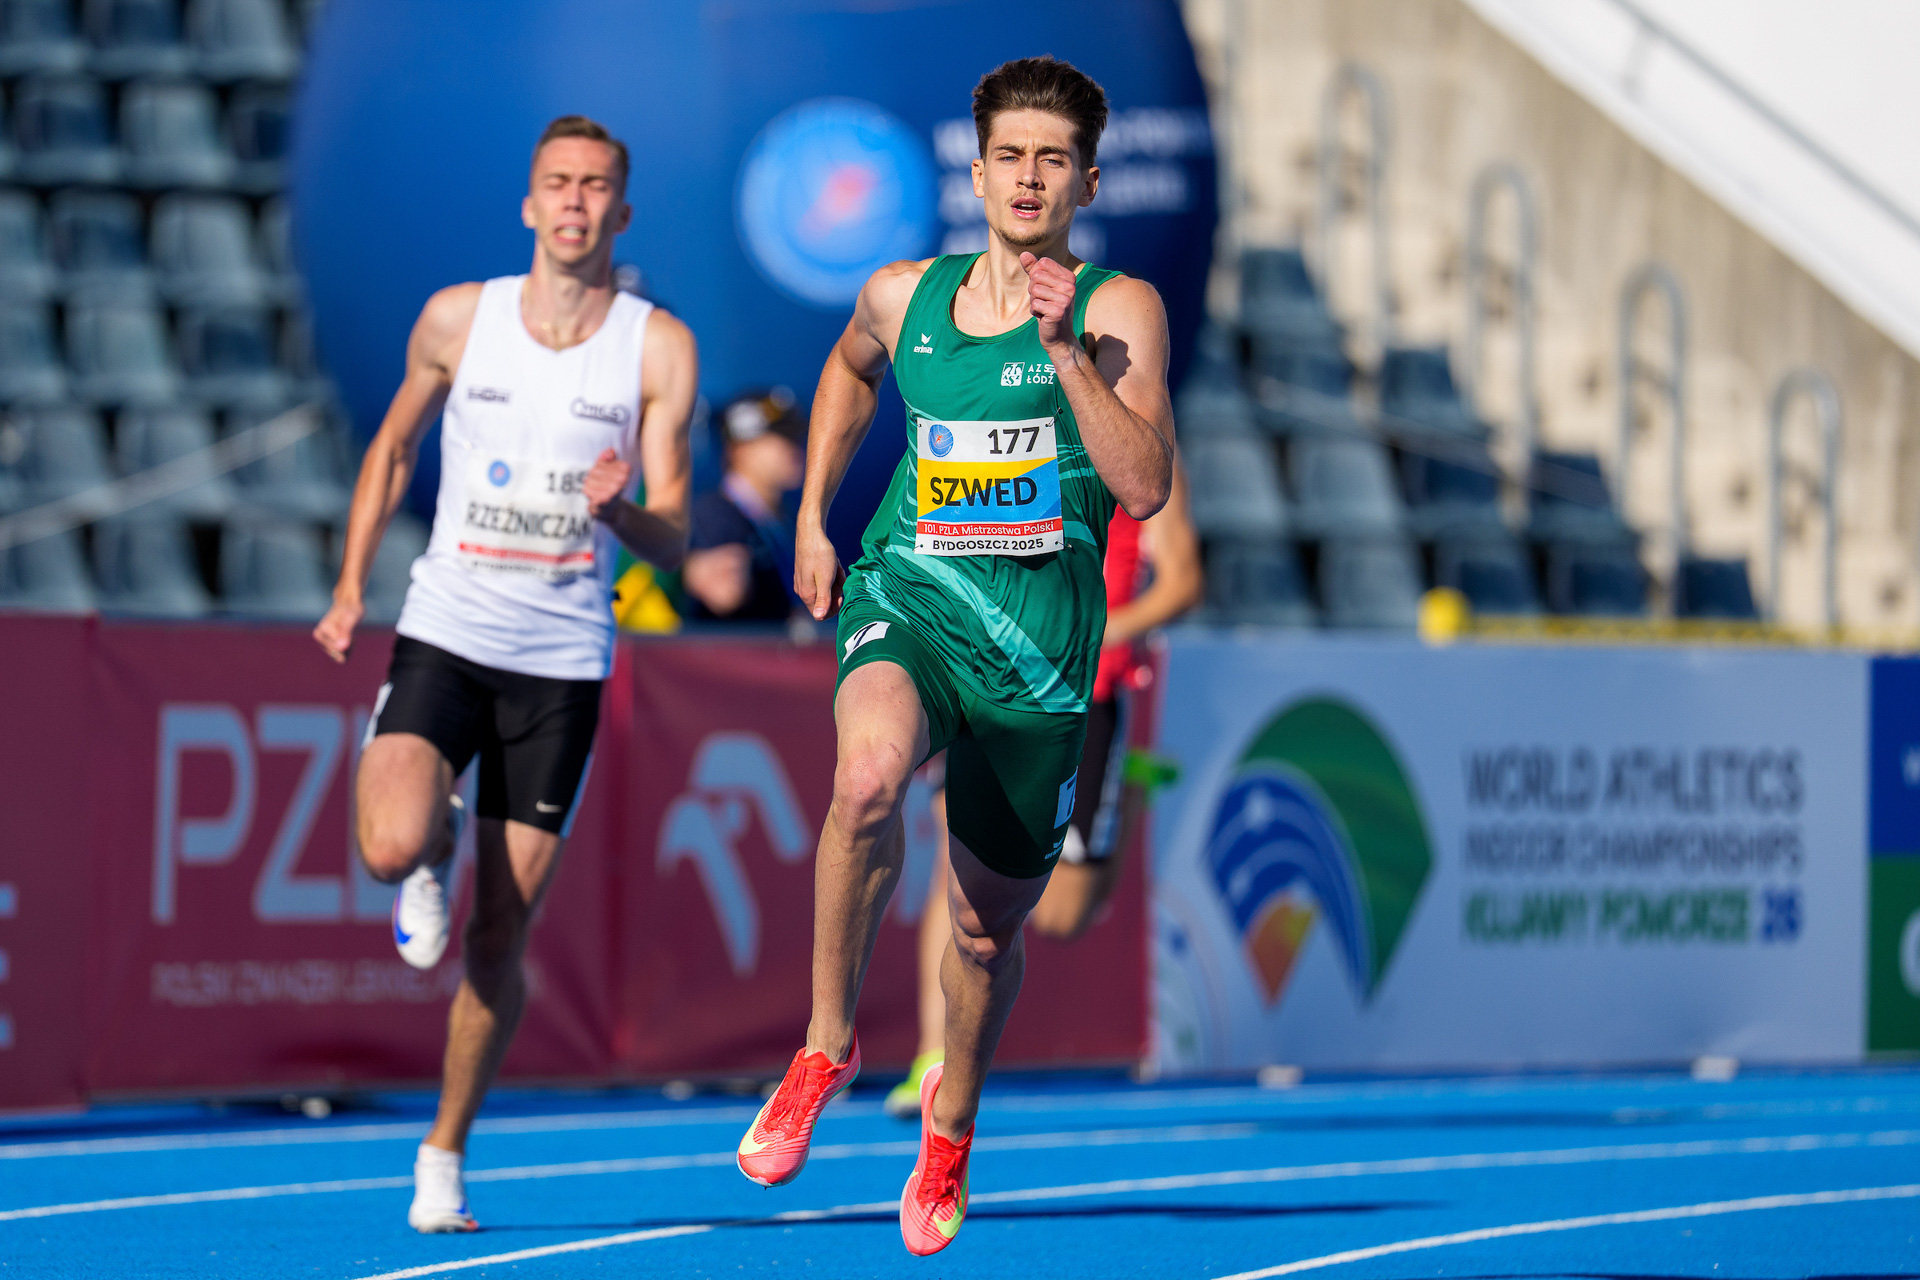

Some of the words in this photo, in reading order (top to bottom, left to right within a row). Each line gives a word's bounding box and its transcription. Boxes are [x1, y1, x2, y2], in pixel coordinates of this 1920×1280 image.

[1026, 373, 1054, 385] ŁÓDŹ
[987, 426, 1040, 455] 177
[930, 477, 1038, 507] SZWED
[924, 523, 938, 534] 101.
[939, 525, 960, 535] PZLA
[961, 525, 1021, 536] Mistrzostwa
[1023, 522, 1054, 534] Polski
[933, 539, 1010, 551] BYDGOSZCZ
[1012, 538, 1044, 550] 2025
[852, 621, 878, 650] 7
